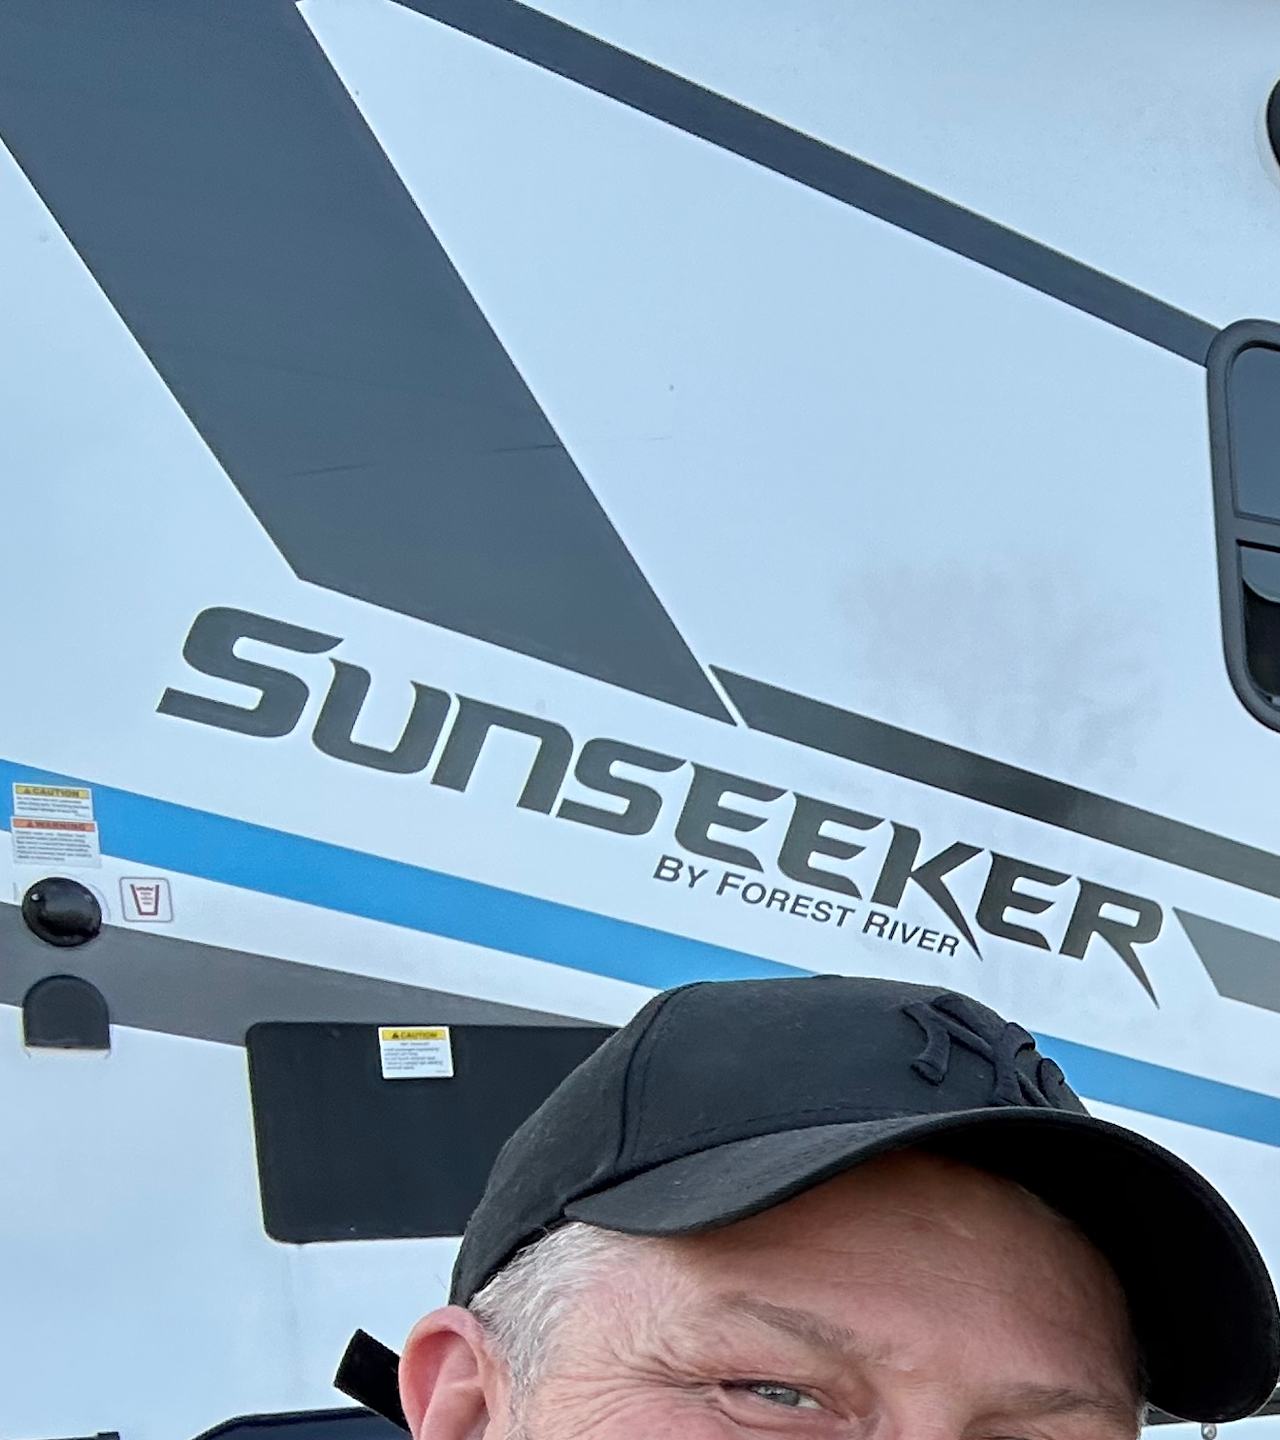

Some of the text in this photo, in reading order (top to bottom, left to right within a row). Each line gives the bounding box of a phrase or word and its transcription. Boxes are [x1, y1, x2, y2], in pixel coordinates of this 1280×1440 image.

[155, 606, 1163, 1010] SUNSEEKER
[653, 855, 960, 957] BY FOREST RIVER
